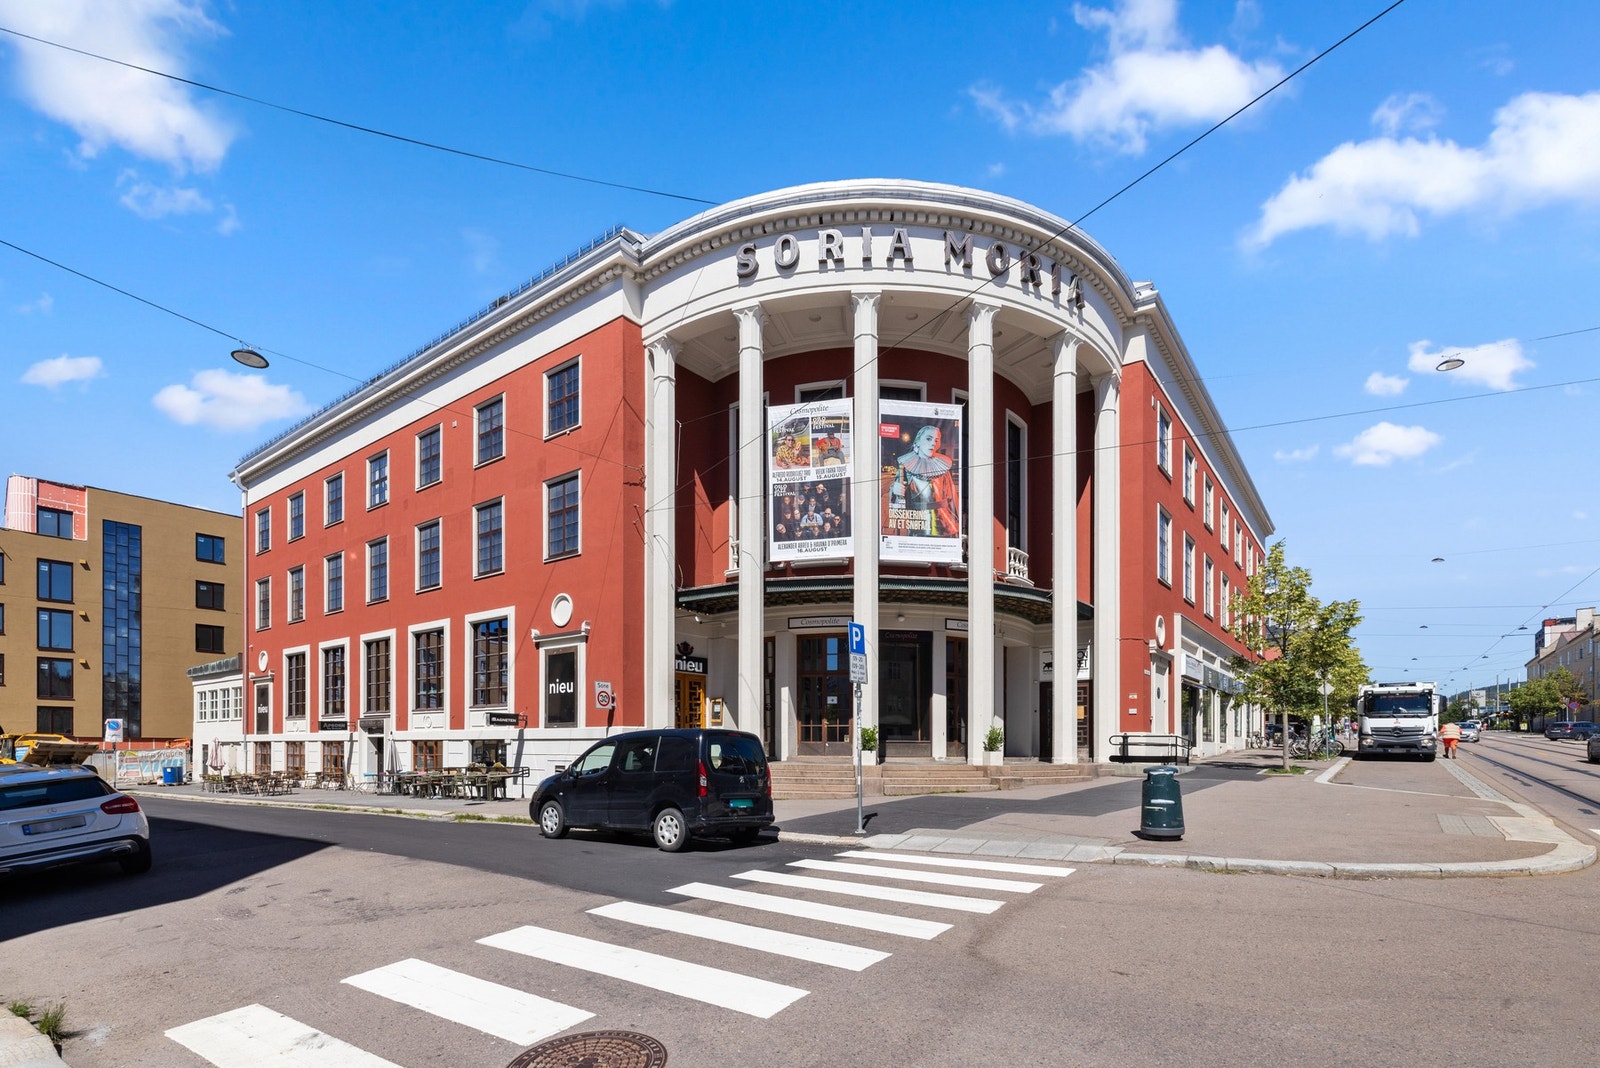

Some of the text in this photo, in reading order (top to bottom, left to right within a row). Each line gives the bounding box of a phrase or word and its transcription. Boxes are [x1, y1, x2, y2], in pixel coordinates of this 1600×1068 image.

[736, 226, 1086, 310] SORIA MORIA
[790, 404, 829, 415] Cosmopolite
[888, 519, 897, 529] AV
[897, 519, 905, 530] ET
[800, 617, 840, 626] Cosmopolite
[852, 626, 861, 650] P
[675, 656, 703, 673] nieu
[549, 678, 574, 694] nieu
